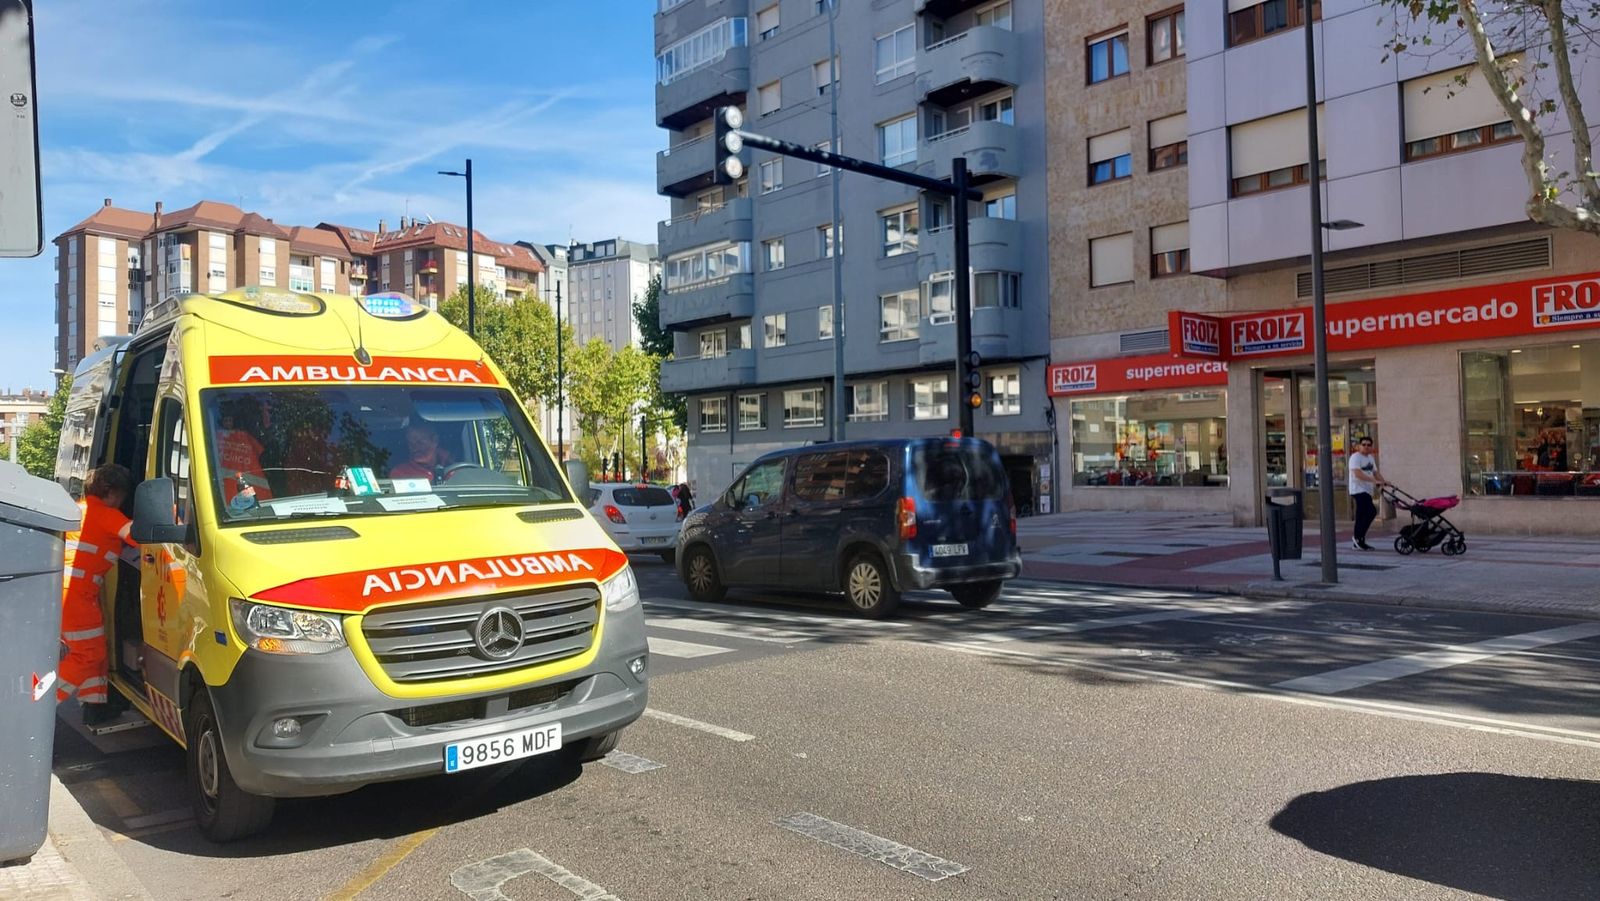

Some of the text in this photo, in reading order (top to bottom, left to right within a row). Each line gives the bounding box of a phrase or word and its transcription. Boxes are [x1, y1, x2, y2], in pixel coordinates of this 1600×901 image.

[1536, 281, 1600, 313] FRO
[1233, 315, 1301, 344] FROIZ
[1552, 313, 1584, 323] Siempre
[1184, 319, 1218, 344] FROIZ
[239, 365, 481, 383] AMBULANCIA
[1054, 367, 1095, 385] FROIZ
[462, 738, 514, 765] 9856
[522, 727, 557, 753] MDF
